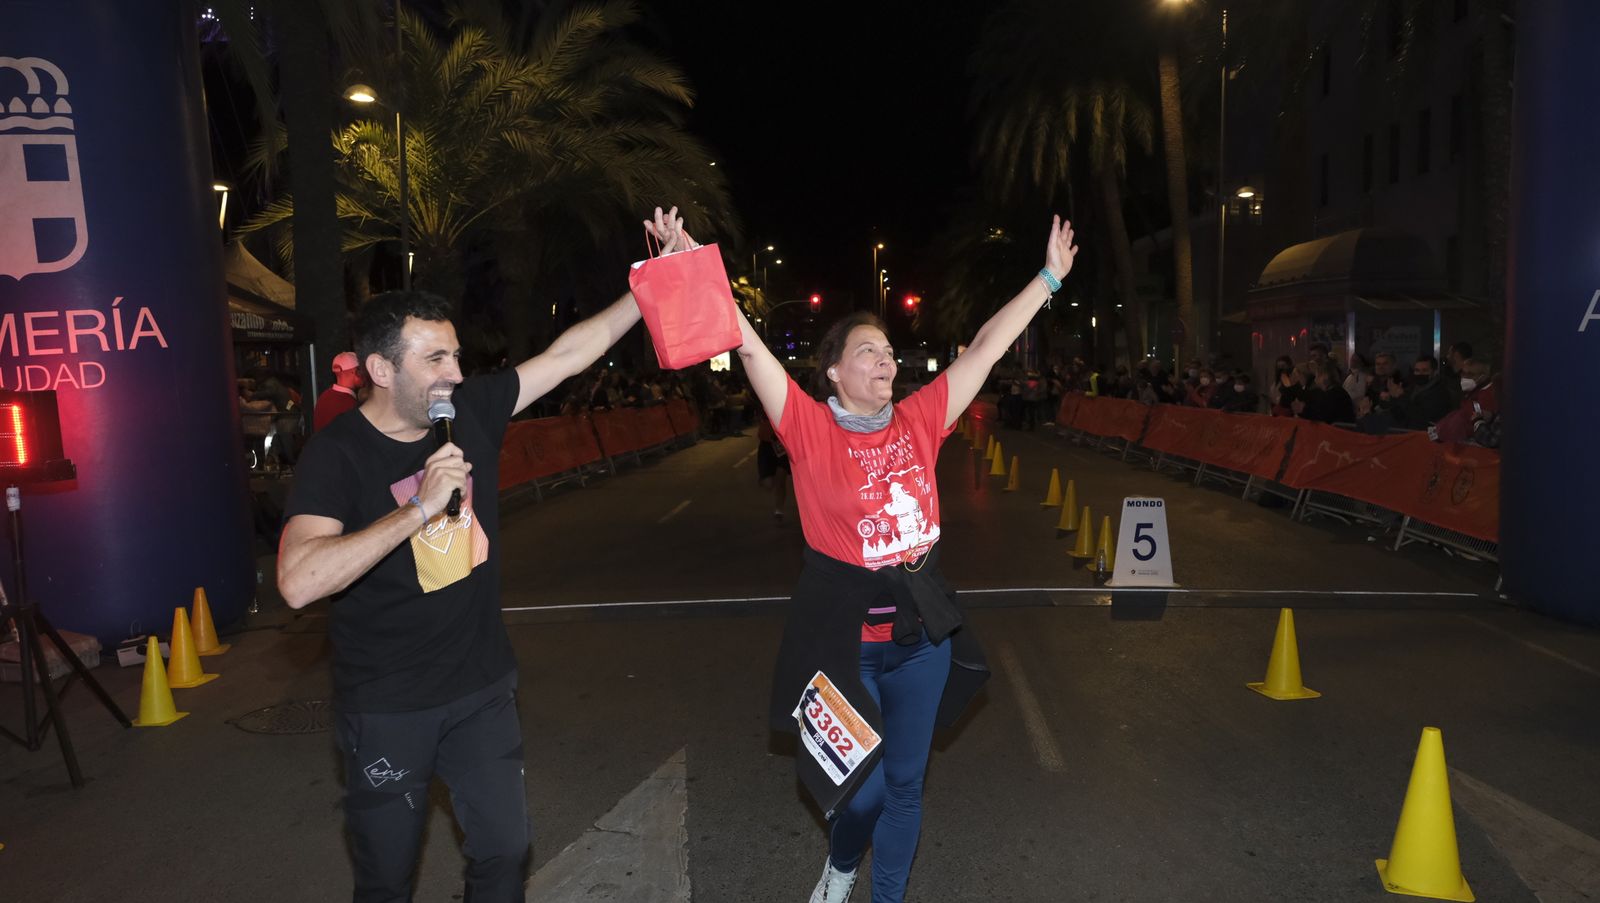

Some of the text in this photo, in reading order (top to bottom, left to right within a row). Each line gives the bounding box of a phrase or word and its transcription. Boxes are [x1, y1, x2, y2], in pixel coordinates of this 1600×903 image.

[1126, 500, 1163, 508] MONDO
[1132, 523, 1157, 561] 5
[809, 700, 854, 757] 3362
[812, 732, 825, 747] PEPA
